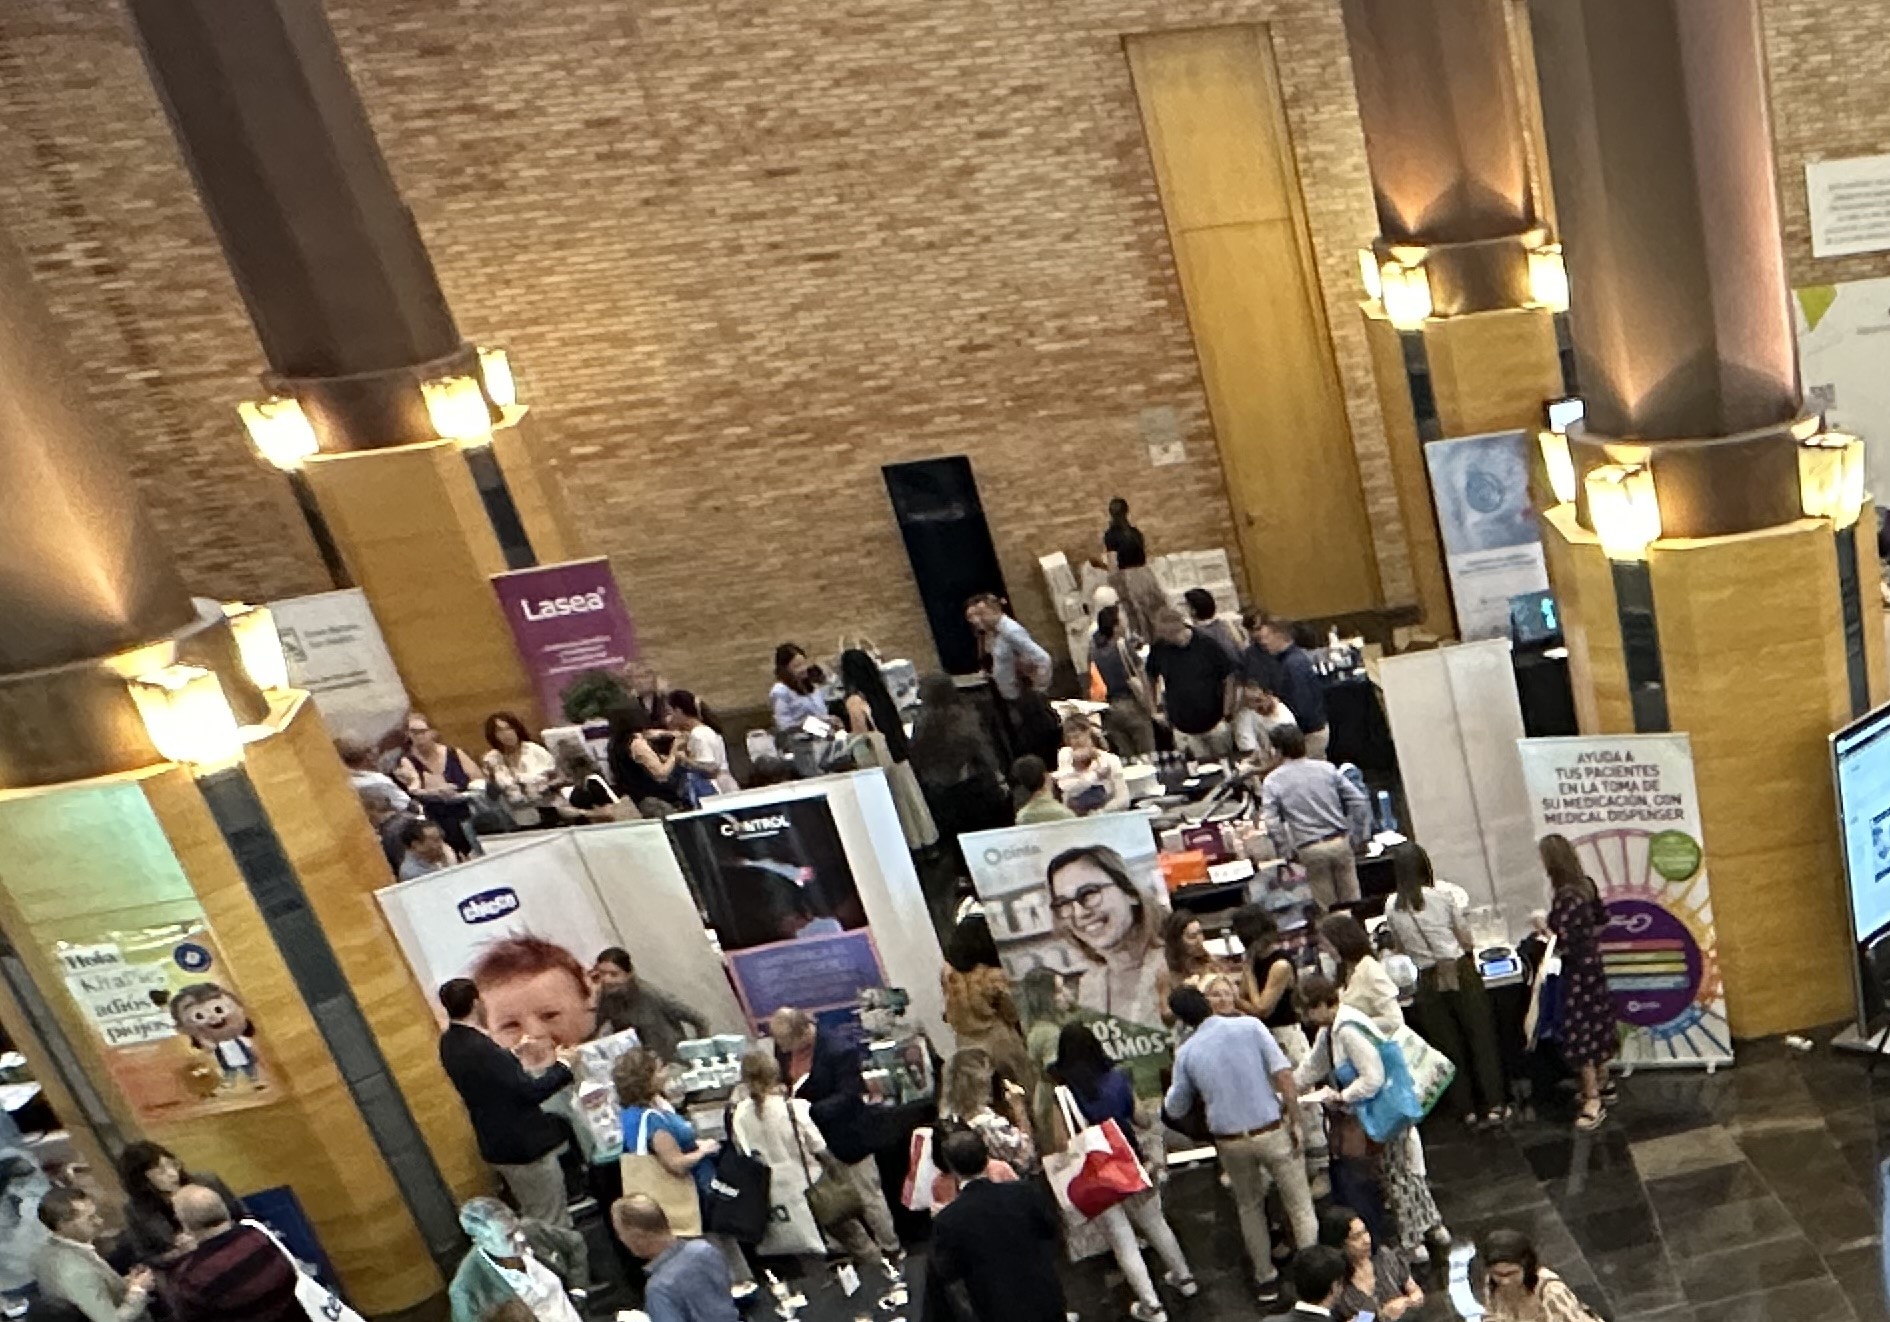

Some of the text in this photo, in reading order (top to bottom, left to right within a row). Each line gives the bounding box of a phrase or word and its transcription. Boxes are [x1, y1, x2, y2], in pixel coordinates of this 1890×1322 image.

[520, 591, 604, 621] Lasea
[1577, 750, 1634, 763] AYUDA A
[1555, 764, 1660, 780] TUS PACIENTES
[1558, 779, 1660, 795] EN LA TOMA DE
[1543, 797, 1560, 810] SU
[1653, 794, 1682, 806] CON
[1544, 808, 1685, 825] MEDICAL DISPENSER
